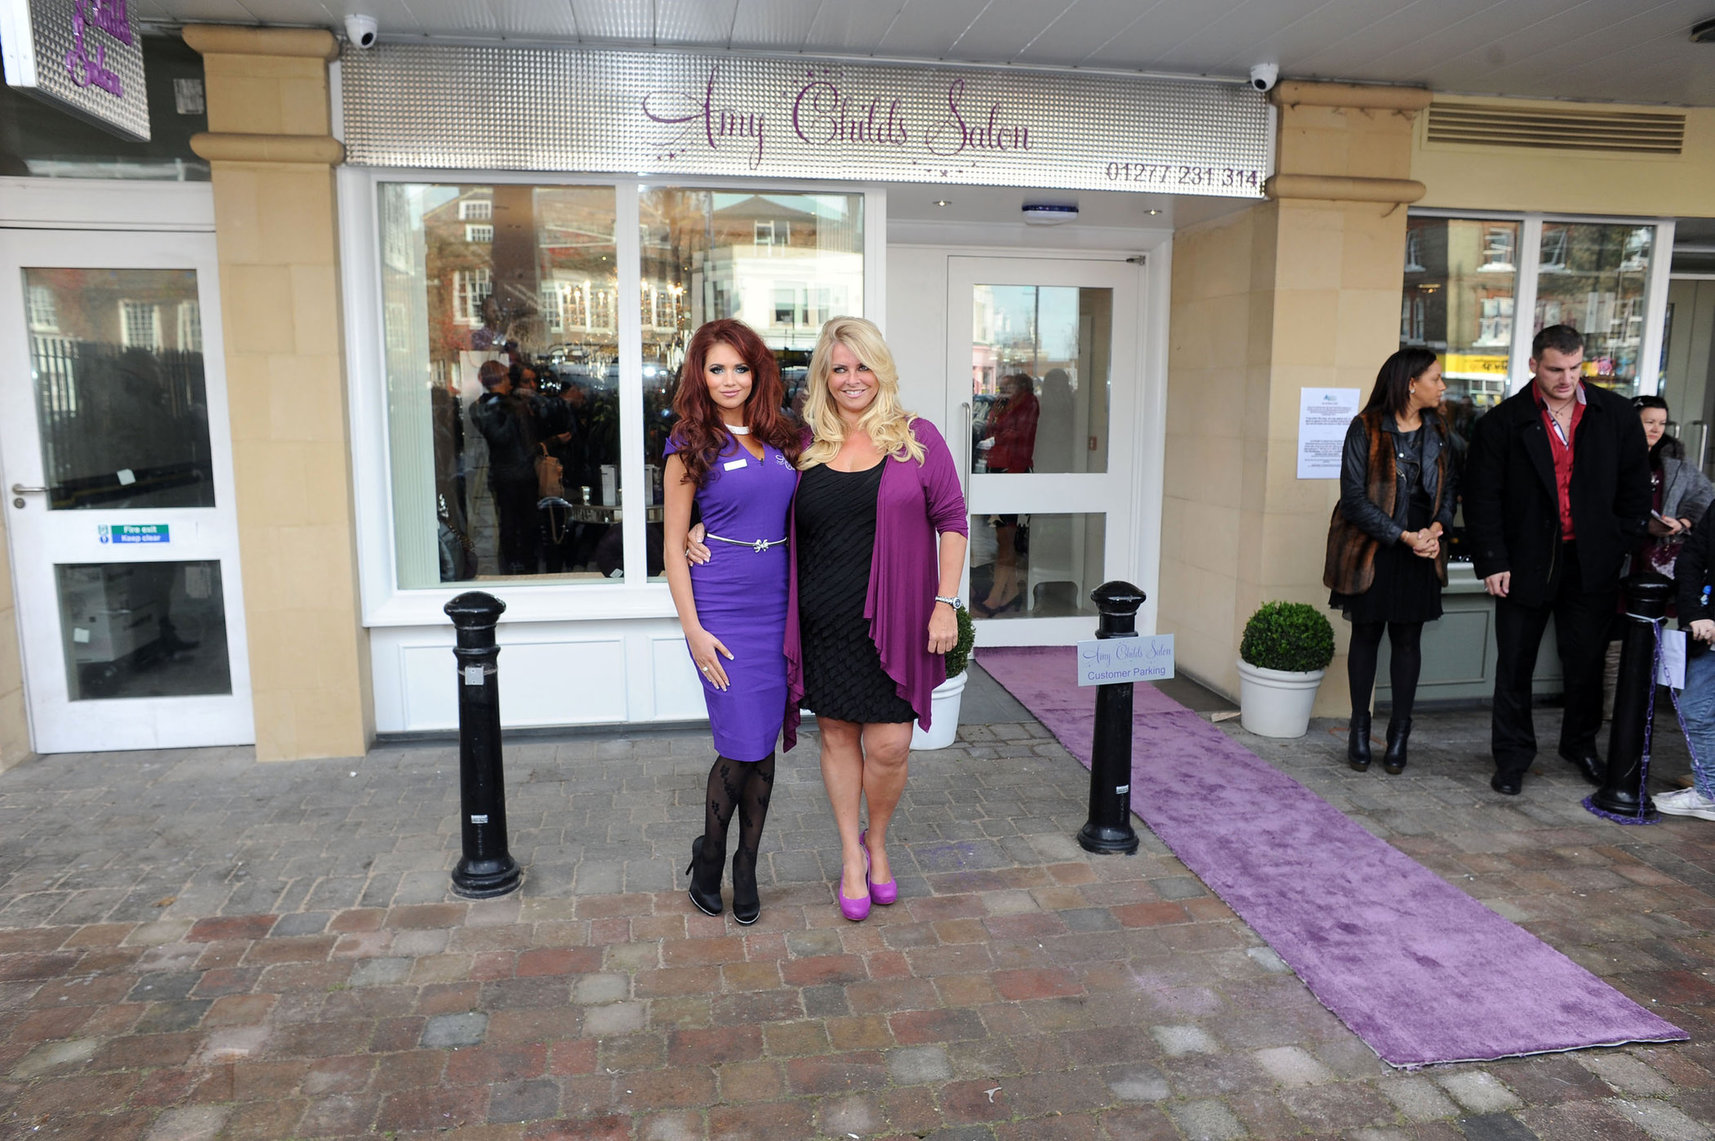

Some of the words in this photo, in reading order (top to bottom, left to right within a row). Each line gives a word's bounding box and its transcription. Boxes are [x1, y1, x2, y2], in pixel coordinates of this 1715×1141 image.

[642, 65, 763, 170] Amy
[793, 81, 906, 145] Childs
[925, 78, 1033, 156] Salon
[1107, 162, 1171, 182] 01277
[1178, 165, 1212, 186] 231
[1222, 168, 1257, 187] 314
[1083, 644, 1111, 666] Amy
[1116, 643, 1143, 660] Childs
[1146, 640, 1171, 659] Salon
[1088, 670, 1131, 680] Customer
[1133, 667, 1166, 677] Parking
